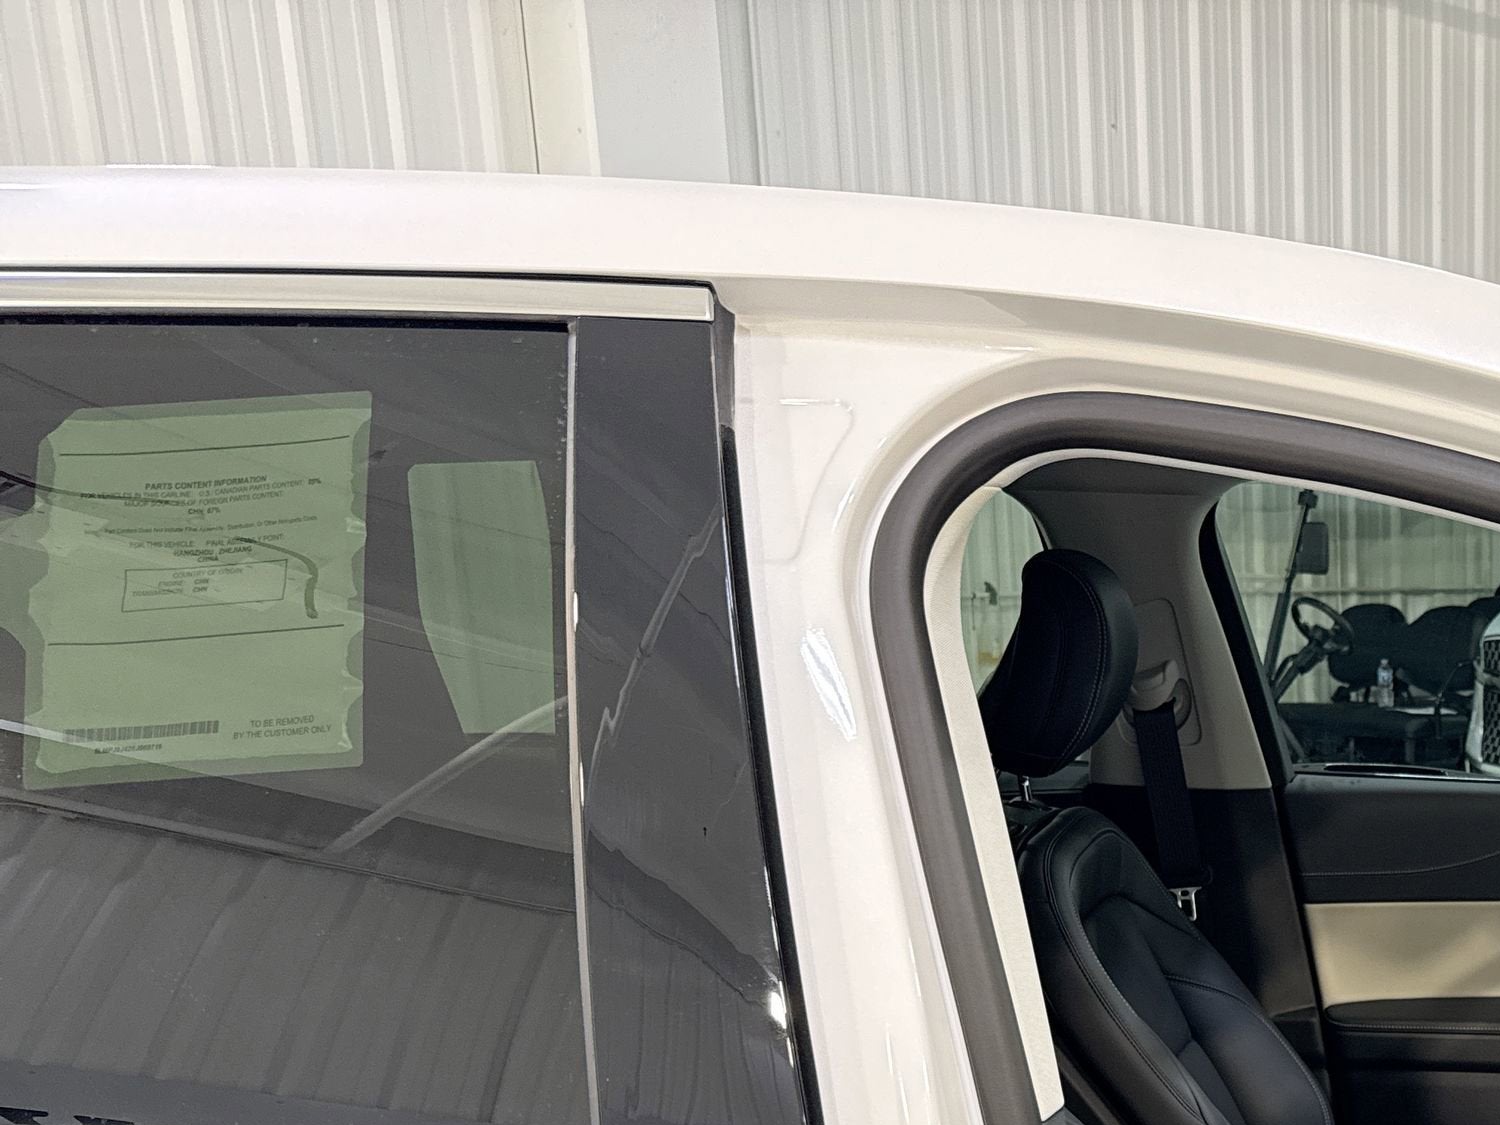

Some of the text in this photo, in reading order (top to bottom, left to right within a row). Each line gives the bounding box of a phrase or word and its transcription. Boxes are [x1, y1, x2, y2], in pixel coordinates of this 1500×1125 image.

[145, 476, 267, 490] PARTS CONTENT INFORMATION
[263, 727, 310, 737] CUSTOMER
